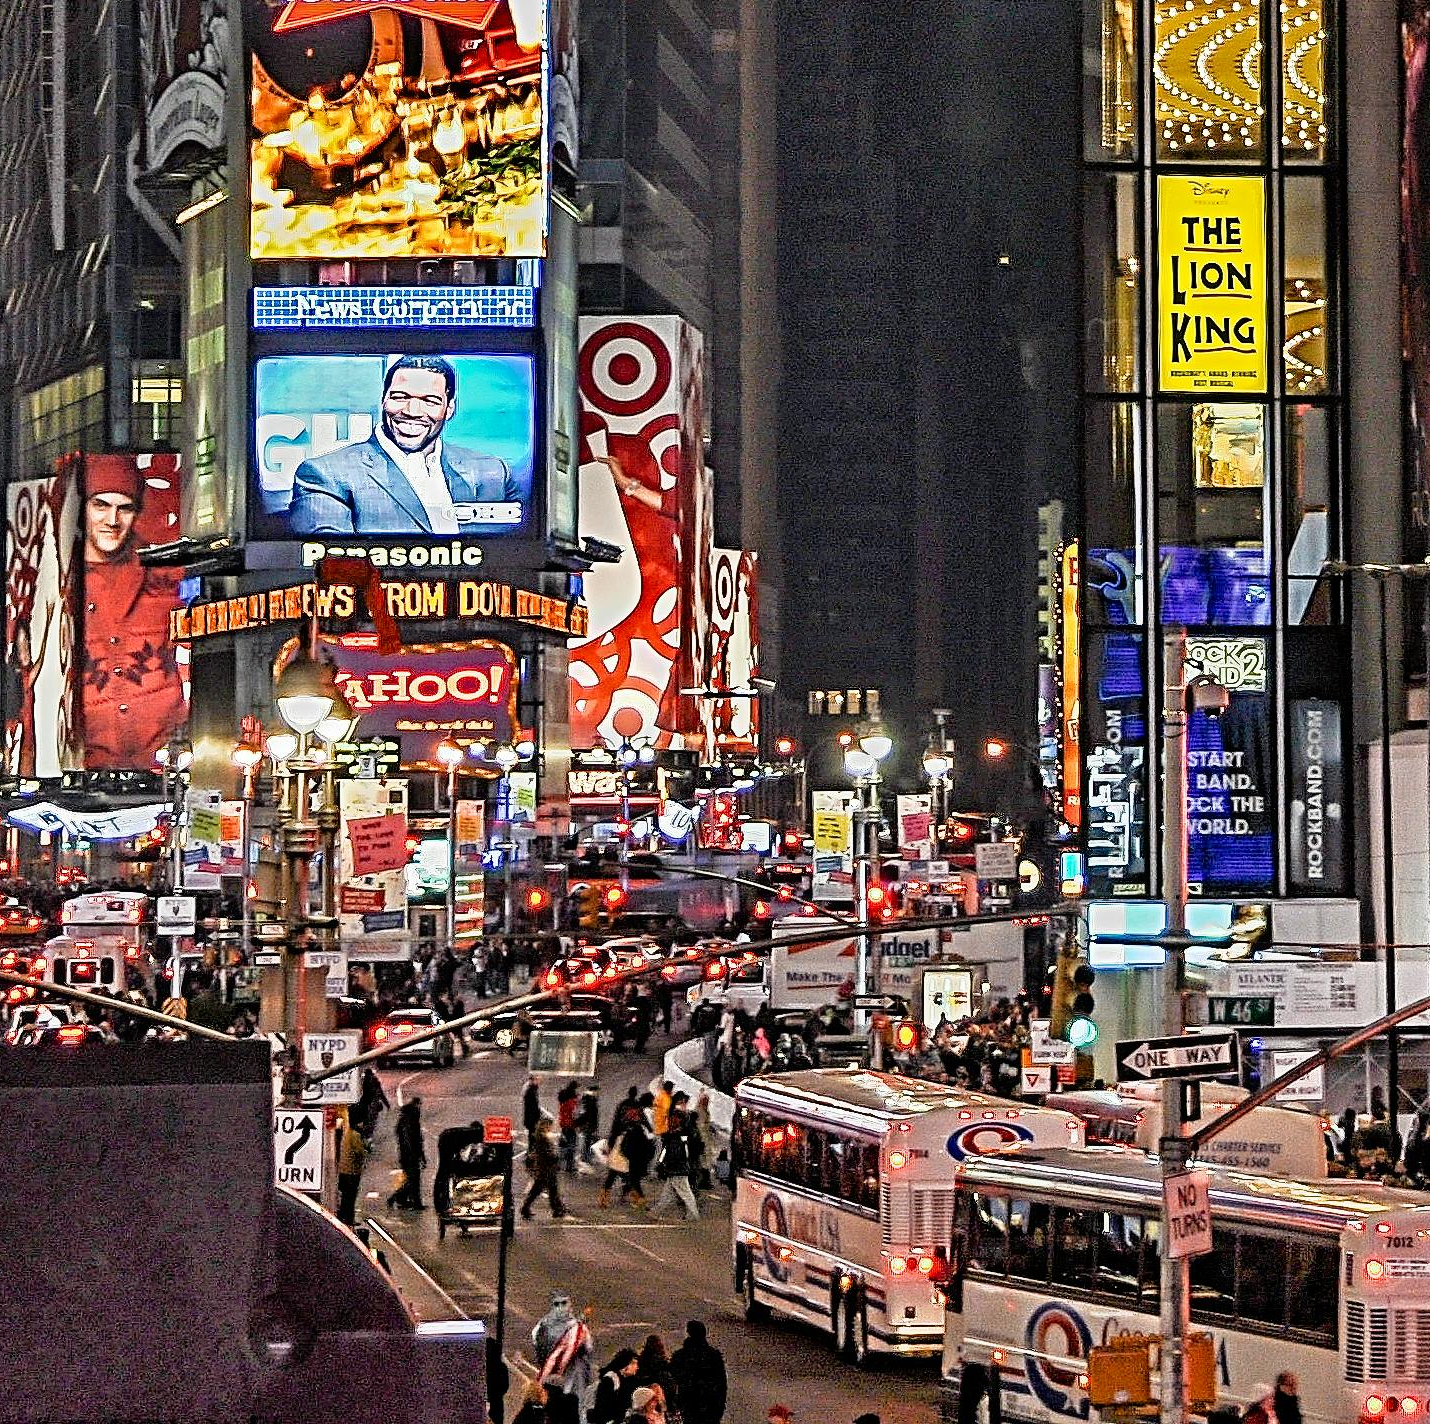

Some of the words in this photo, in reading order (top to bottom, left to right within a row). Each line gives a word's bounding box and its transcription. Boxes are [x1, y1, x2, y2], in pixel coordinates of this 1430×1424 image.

[1181, 217, 1242, 245] THE
[1171, 255, 1252, 305] LION
[297, 294, 361, 320] News
[1171, 313, 1255, 363] KING
[1244, 653, 1263, 676] 2
[1187, 751, 1245, 767] START
[1196, 774, 1256, 790] BAND.
[1231, 796, 1265, 813] THE
[1306, 710, 1324, 879] ROCKBAND.COM
[308, 1038, 347, 1052] NYPD
[277, 1167, 315, 1185] URN
[1176, 1184, 1198, 1207] NO
